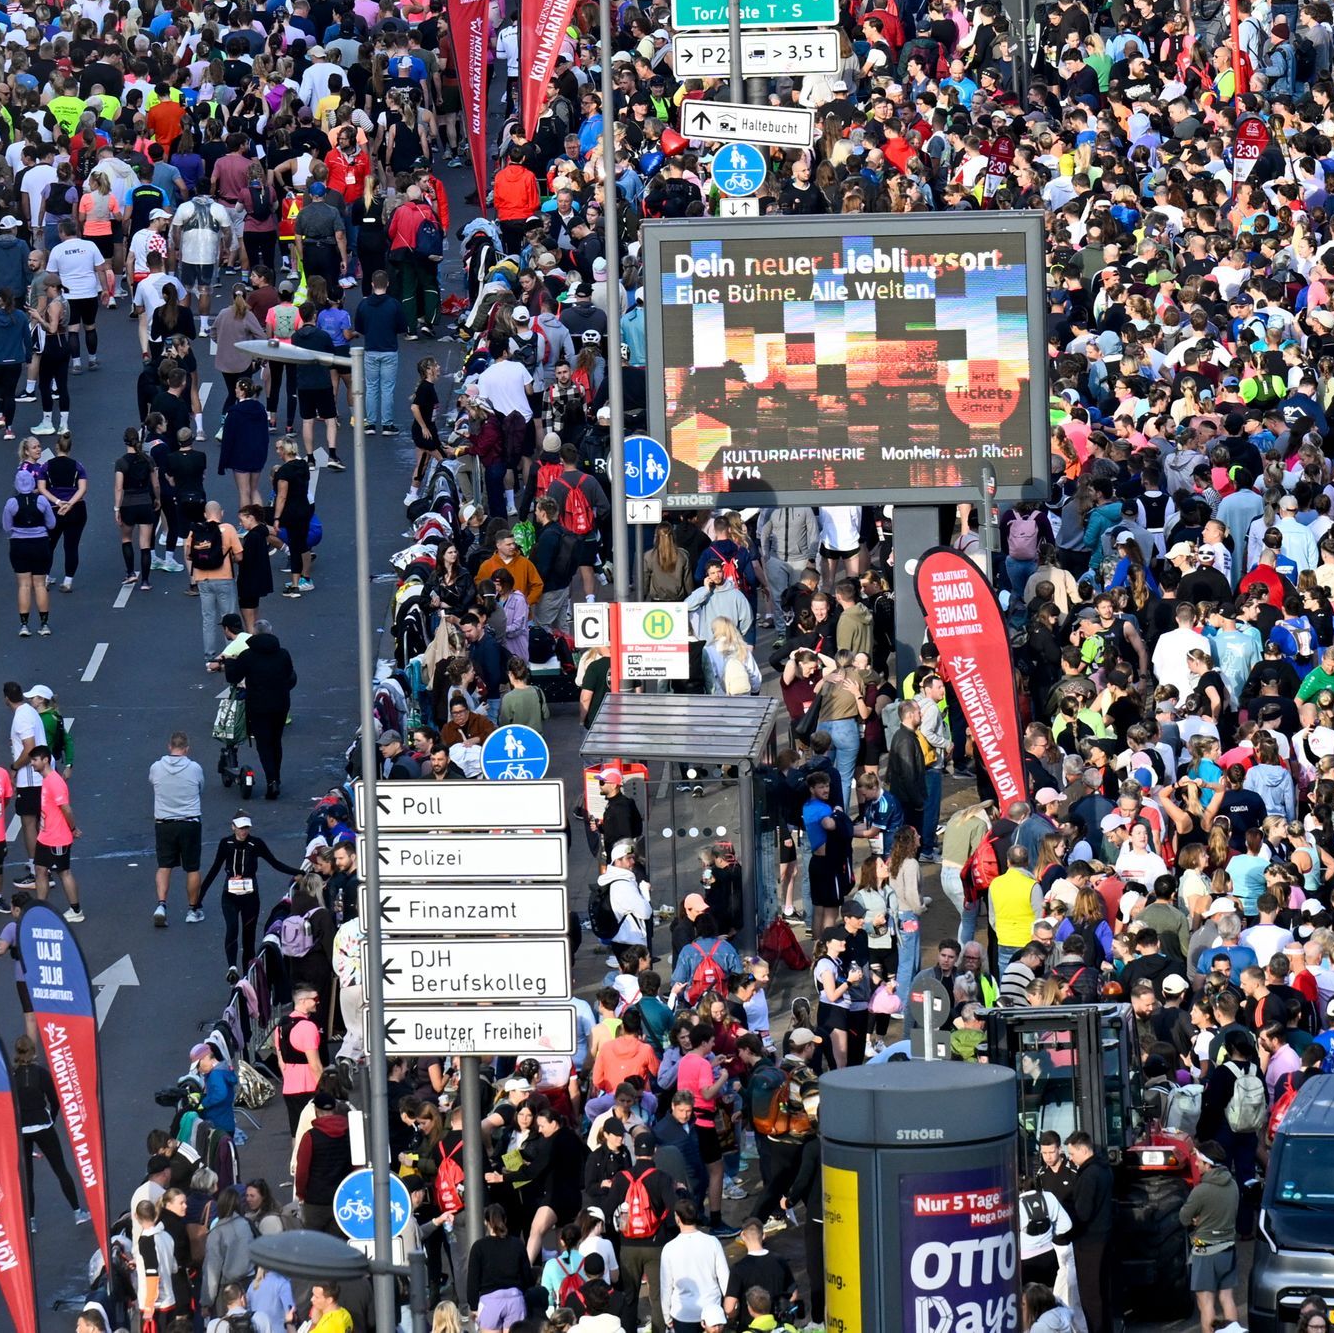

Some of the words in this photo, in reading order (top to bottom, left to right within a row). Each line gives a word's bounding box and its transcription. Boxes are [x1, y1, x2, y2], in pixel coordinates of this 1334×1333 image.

[767, 5, 777, 18] T
[792, 4, 803, 18] S
[788, 45, 813, 61] 3,5
[473, 37, 483, 106] MARATHON
[529, 50, 550, 82] KÖLN
[741, 118, 798, 135] Haltebucht
[675, 253, 735, 279] Dein
[745, 254, 818, 278] neuer
[833, 247, 1012, 279] Lieblingsort.
[676, 284, 720, 304] Eine
[727, 283, 803, 304] Bühne.
[810, 280, 848, 301] Alle
[854, 279, 936, 301] Welten.
[954, 385, 1012, 401] Tickets
[722, 447, 866, 465] KULTURRAFFINERIE
[982, 443, 1023, 459] Rhein
[722, 465, 761, 481] K714
[667, 493, 714, 507] STRÖER
[581, 616, 600, 640] C
[651, 615, 665, 634] H
[628, 656, 643, 664] 150
[402, 796, 442, 815] Poll
[1230, 805, 1248, 813] CONDA
[400, 849, 462, 866] Polizei
[410, 900, 517, 919] Finanzamt
[411, 950, 452, 968] DJH
[412, 973, 547, 995] Berufskolleg
[415, 1022, 473, 1041] Deutzer
[484, 1022, 543, 1040] Freiheit
[896, 1128, 944, 1140] STRÖER
[917, 1196, 949, 1213] Nur
[953, 1194, 964, 1211] 5
[967, 1192, 1000, 1211] Tage
[971, 1212, 996, 1225] Mega
[910, 1230, 1016, 1291] OTTO
[915, 1293, 1018, 1333] Days
